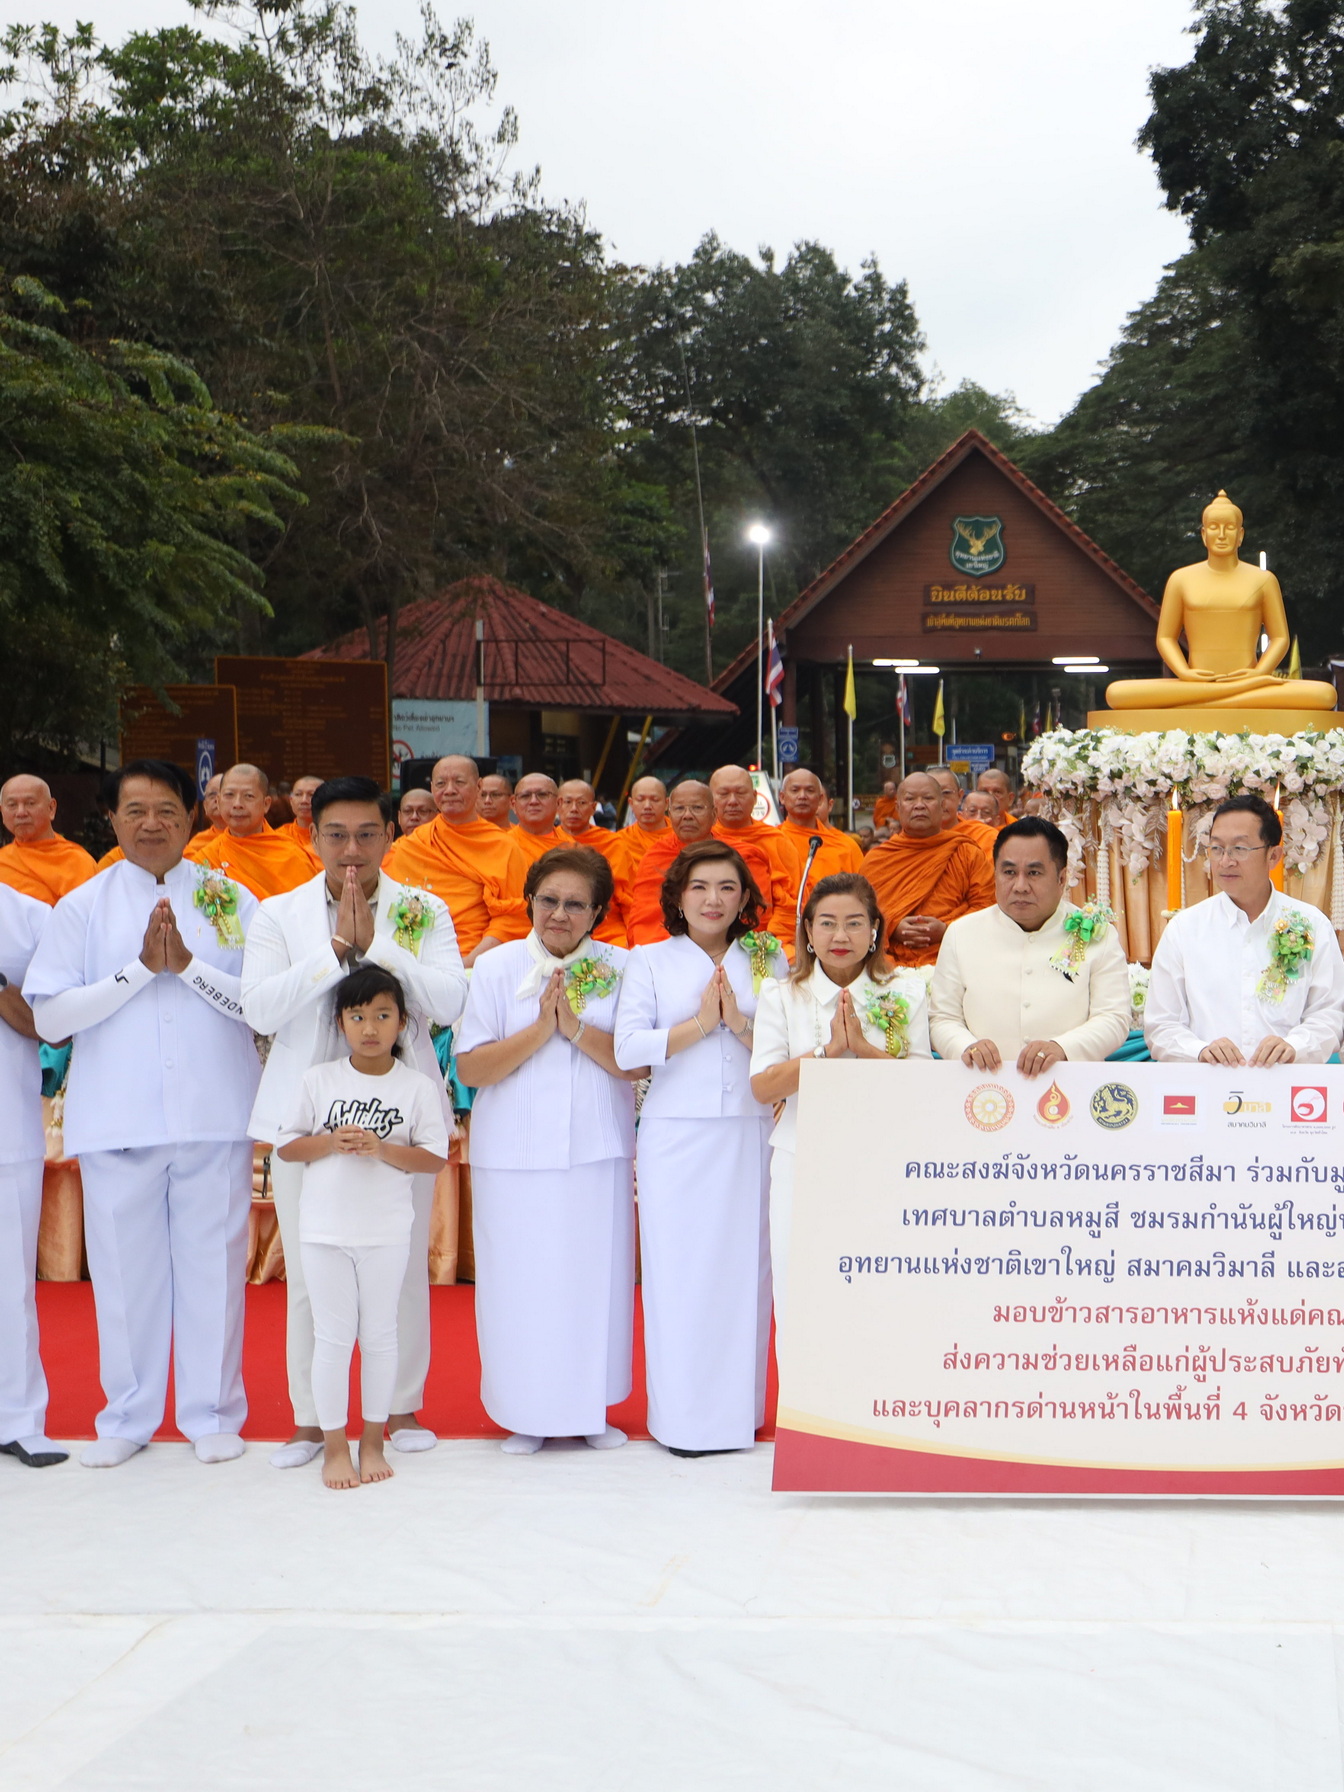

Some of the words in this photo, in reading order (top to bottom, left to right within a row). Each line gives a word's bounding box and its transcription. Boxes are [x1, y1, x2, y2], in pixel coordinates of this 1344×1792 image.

[931, 584, 1026, 602] ยินดีต้อนรับ
[323, 1097, 404, 1139] Adidas
[905, 1153, 1235, 1182] คณะสงฆ์จังหวัดนครราชสีมา
[902, 1201, 1119, 1238] เทศบาลตำบลหมูสี
[839, 1246, 1115, 1283] อุทยานแห่งชาติเขาใหญ่
[1128, 1251, 1275, 1277] สมาคมวิมาลี
[872, 1385, 1221, 1428] และบุคลากรด่านหน้าในพื้นที่
[1233, 1402, 1248, 1421] 4
